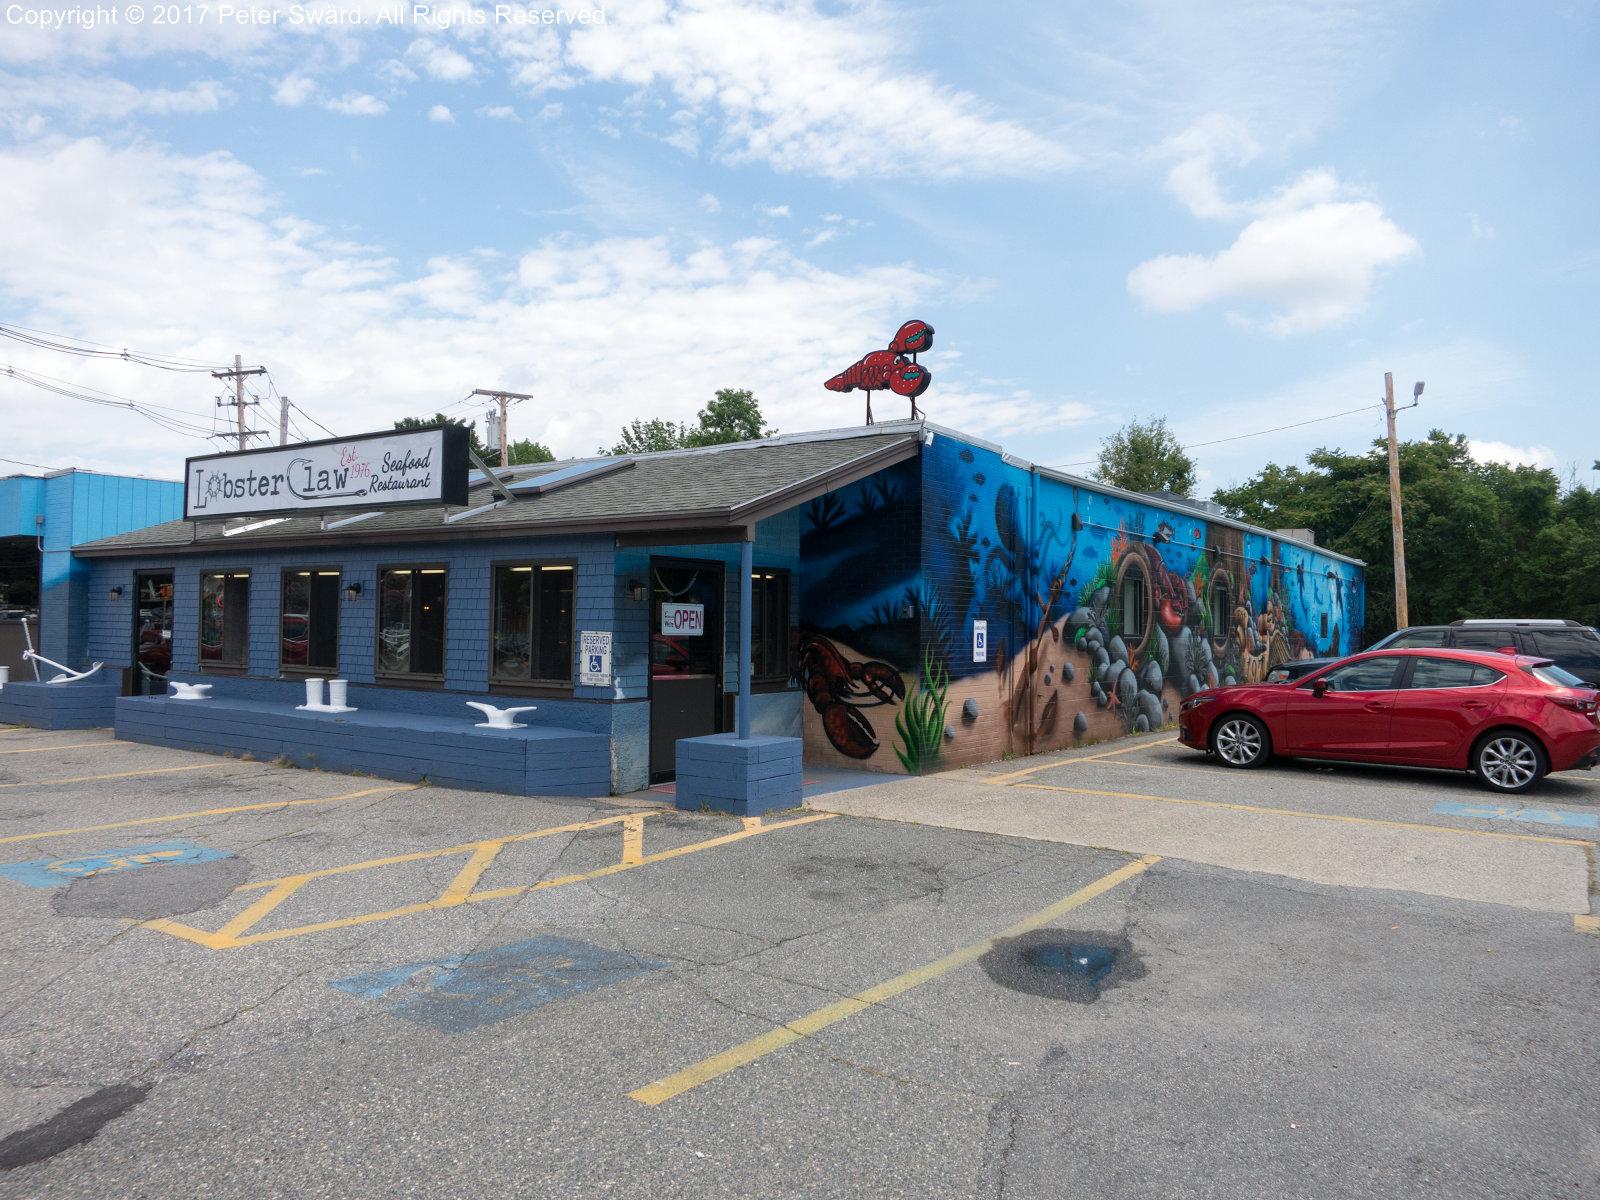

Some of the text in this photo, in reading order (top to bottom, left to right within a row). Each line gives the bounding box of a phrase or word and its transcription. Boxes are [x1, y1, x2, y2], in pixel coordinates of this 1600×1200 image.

[340, 446, 359, 467] Est.
[381, 447, 432, 477] Seafood
[350, 462, 371, 479] 1976
[193, 457, 350, 509] Lobster Claw
[368, 472, 431, 493] Restaurant
[673, 609, 702, 630] OPEN
[583, 635, 610, 645] RESERVED
[584, 645, 607, 655] PARKING
